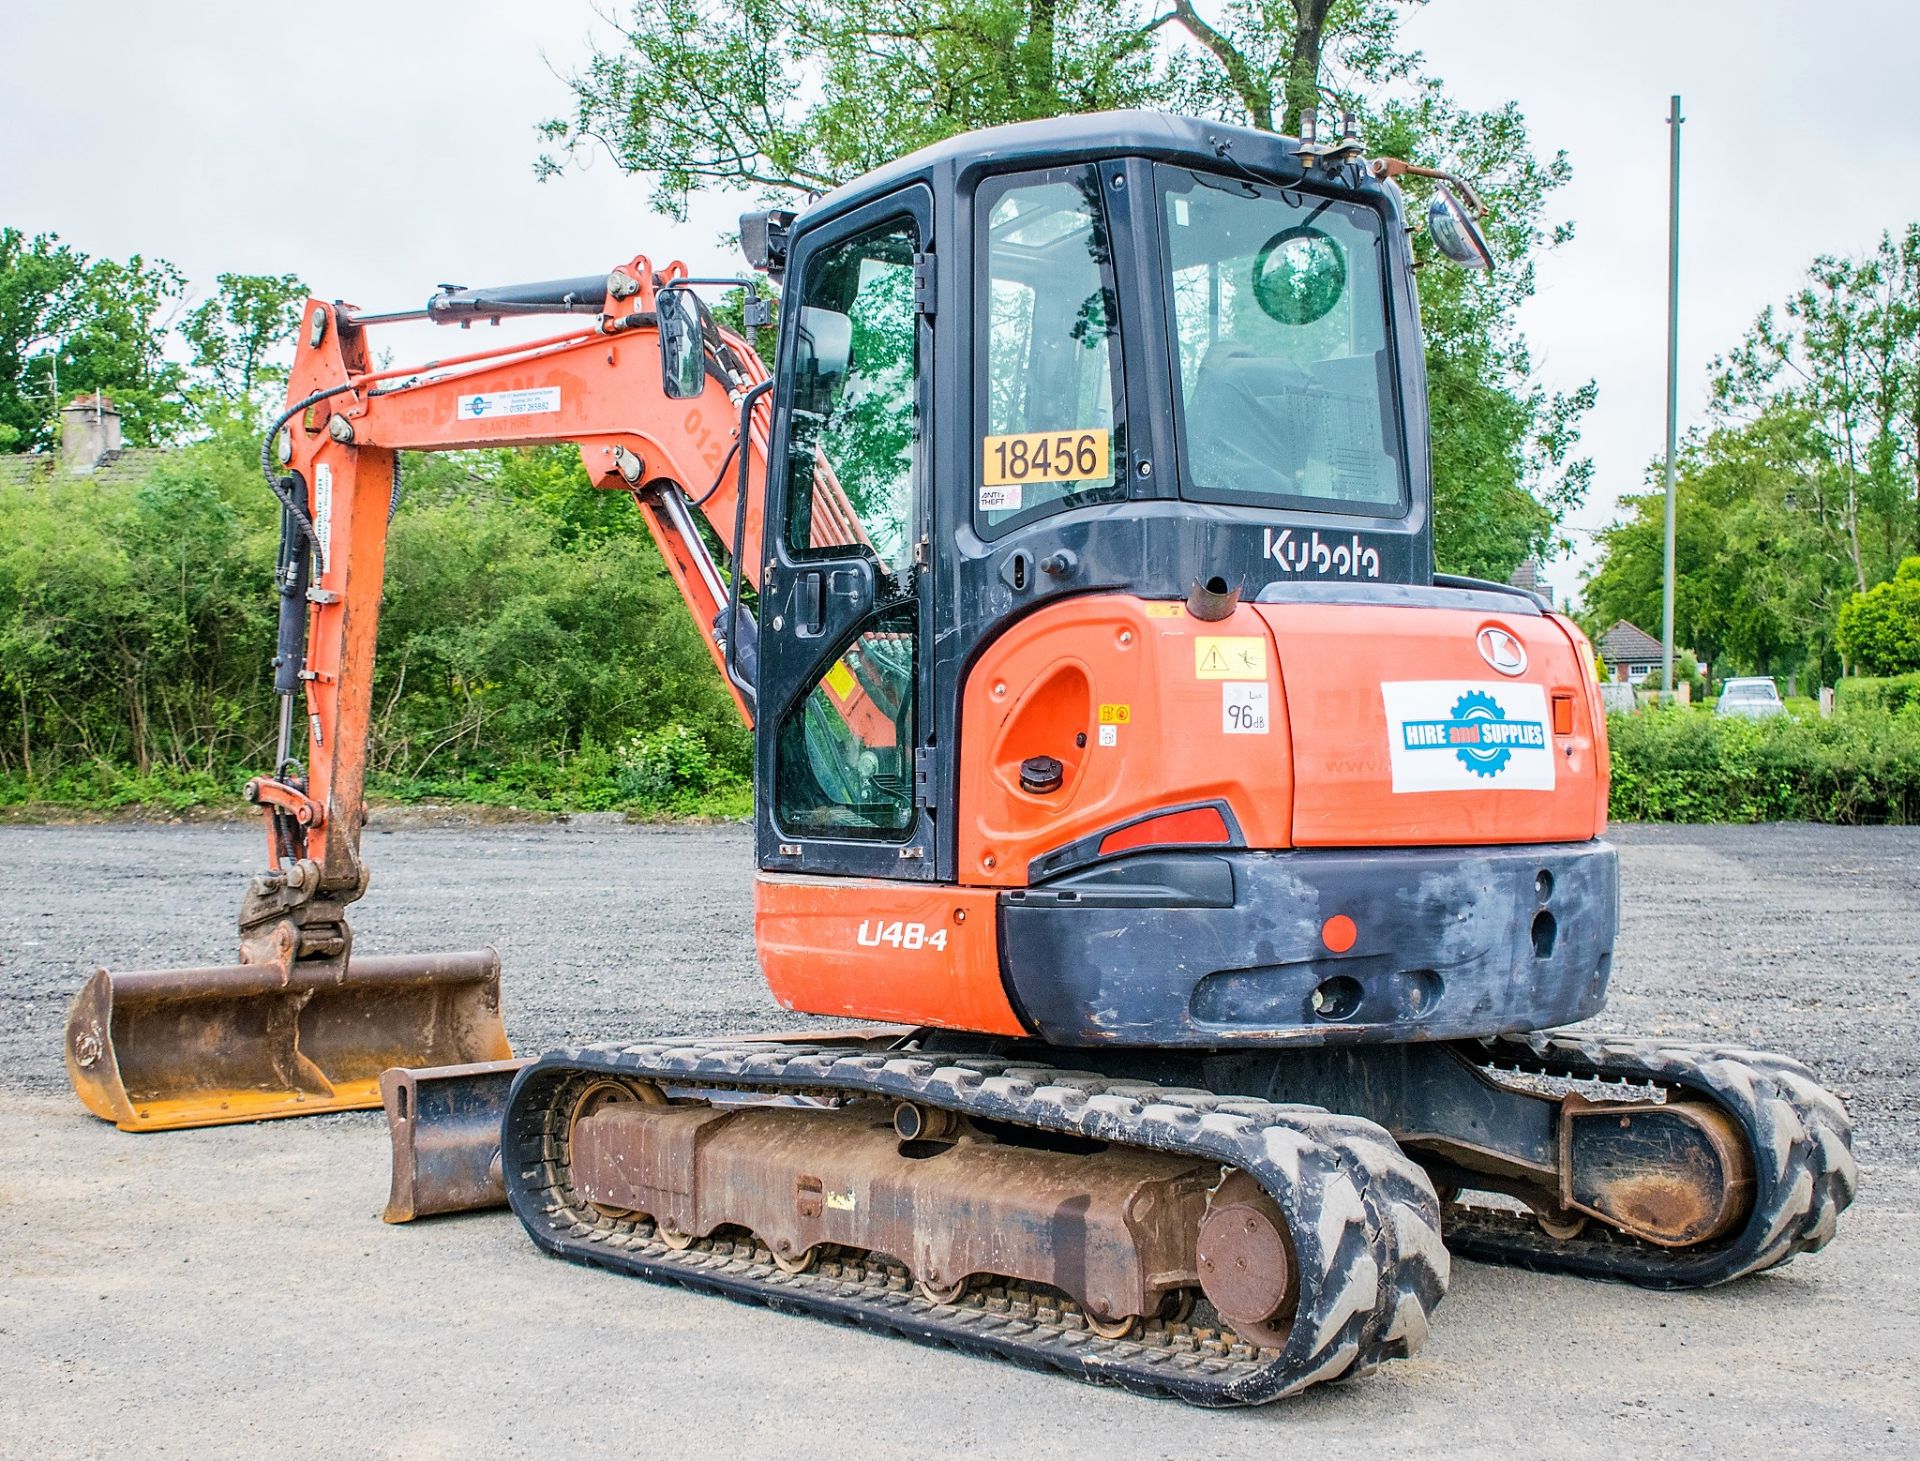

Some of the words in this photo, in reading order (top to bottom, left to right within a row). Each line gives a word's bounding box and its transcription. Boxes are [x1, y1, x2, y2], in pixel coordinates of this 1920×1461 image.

[478, 419, 508, 434] PLANT
[510, 415, 532, 429] HIRE
[994, 434, 1097, 479] 18456
[981, 498, 1005, 506] THEFT
[1263, 528, 1379, 578] Kubota
[1406, 723, 1447, 746] HIRE
[1449, 723, 1480, 744] and
[1482, 722, 1544, 746] SUPPLIES
[857, 919, 948, 952] U48-4
